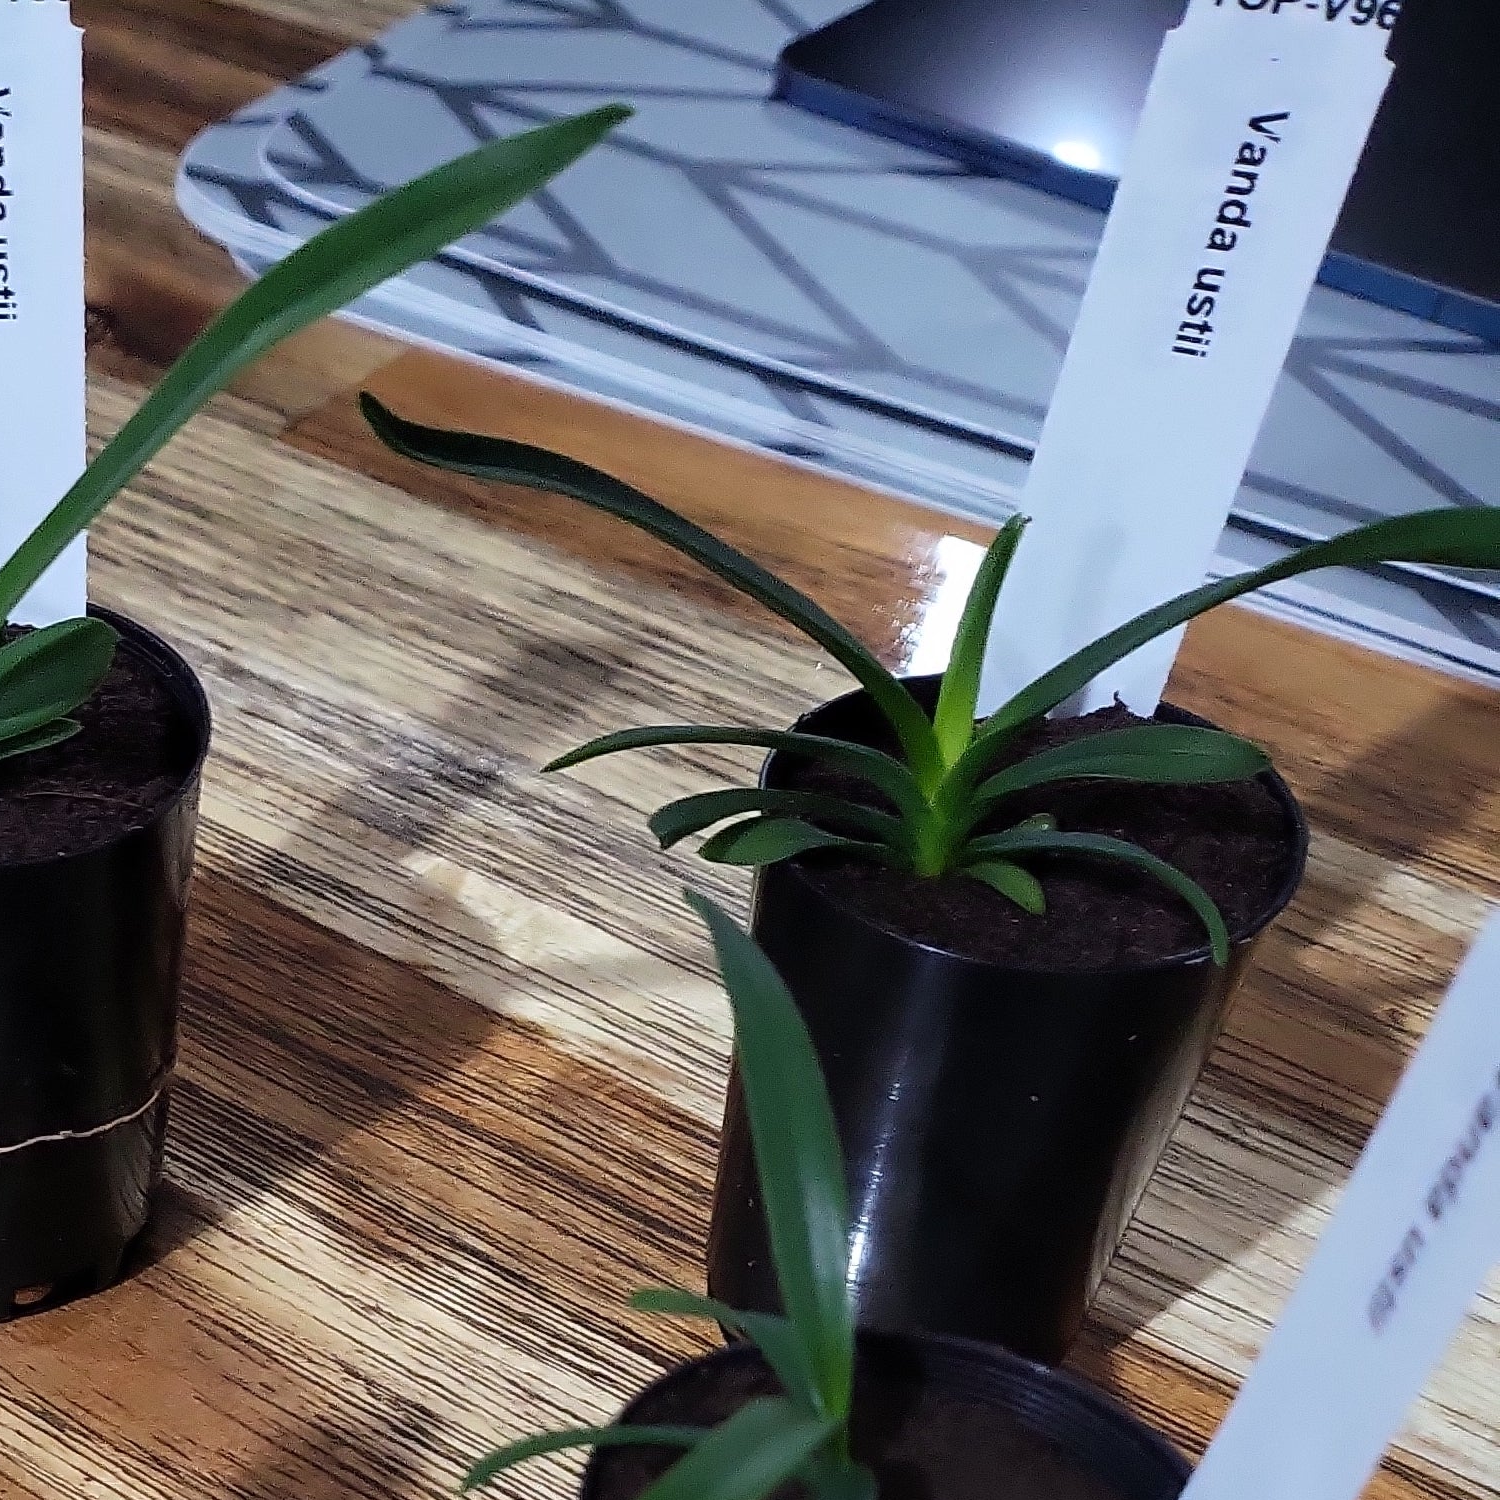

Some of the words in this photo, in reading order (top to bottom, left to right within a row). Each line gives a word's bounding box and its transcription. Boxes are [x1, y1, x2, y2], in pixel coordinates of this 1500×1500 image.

[1214, 0, 1401, 30] -V96
[1205, 111, 1291, 252] Vanda
[1171, 266, 1226, 358] ustii
